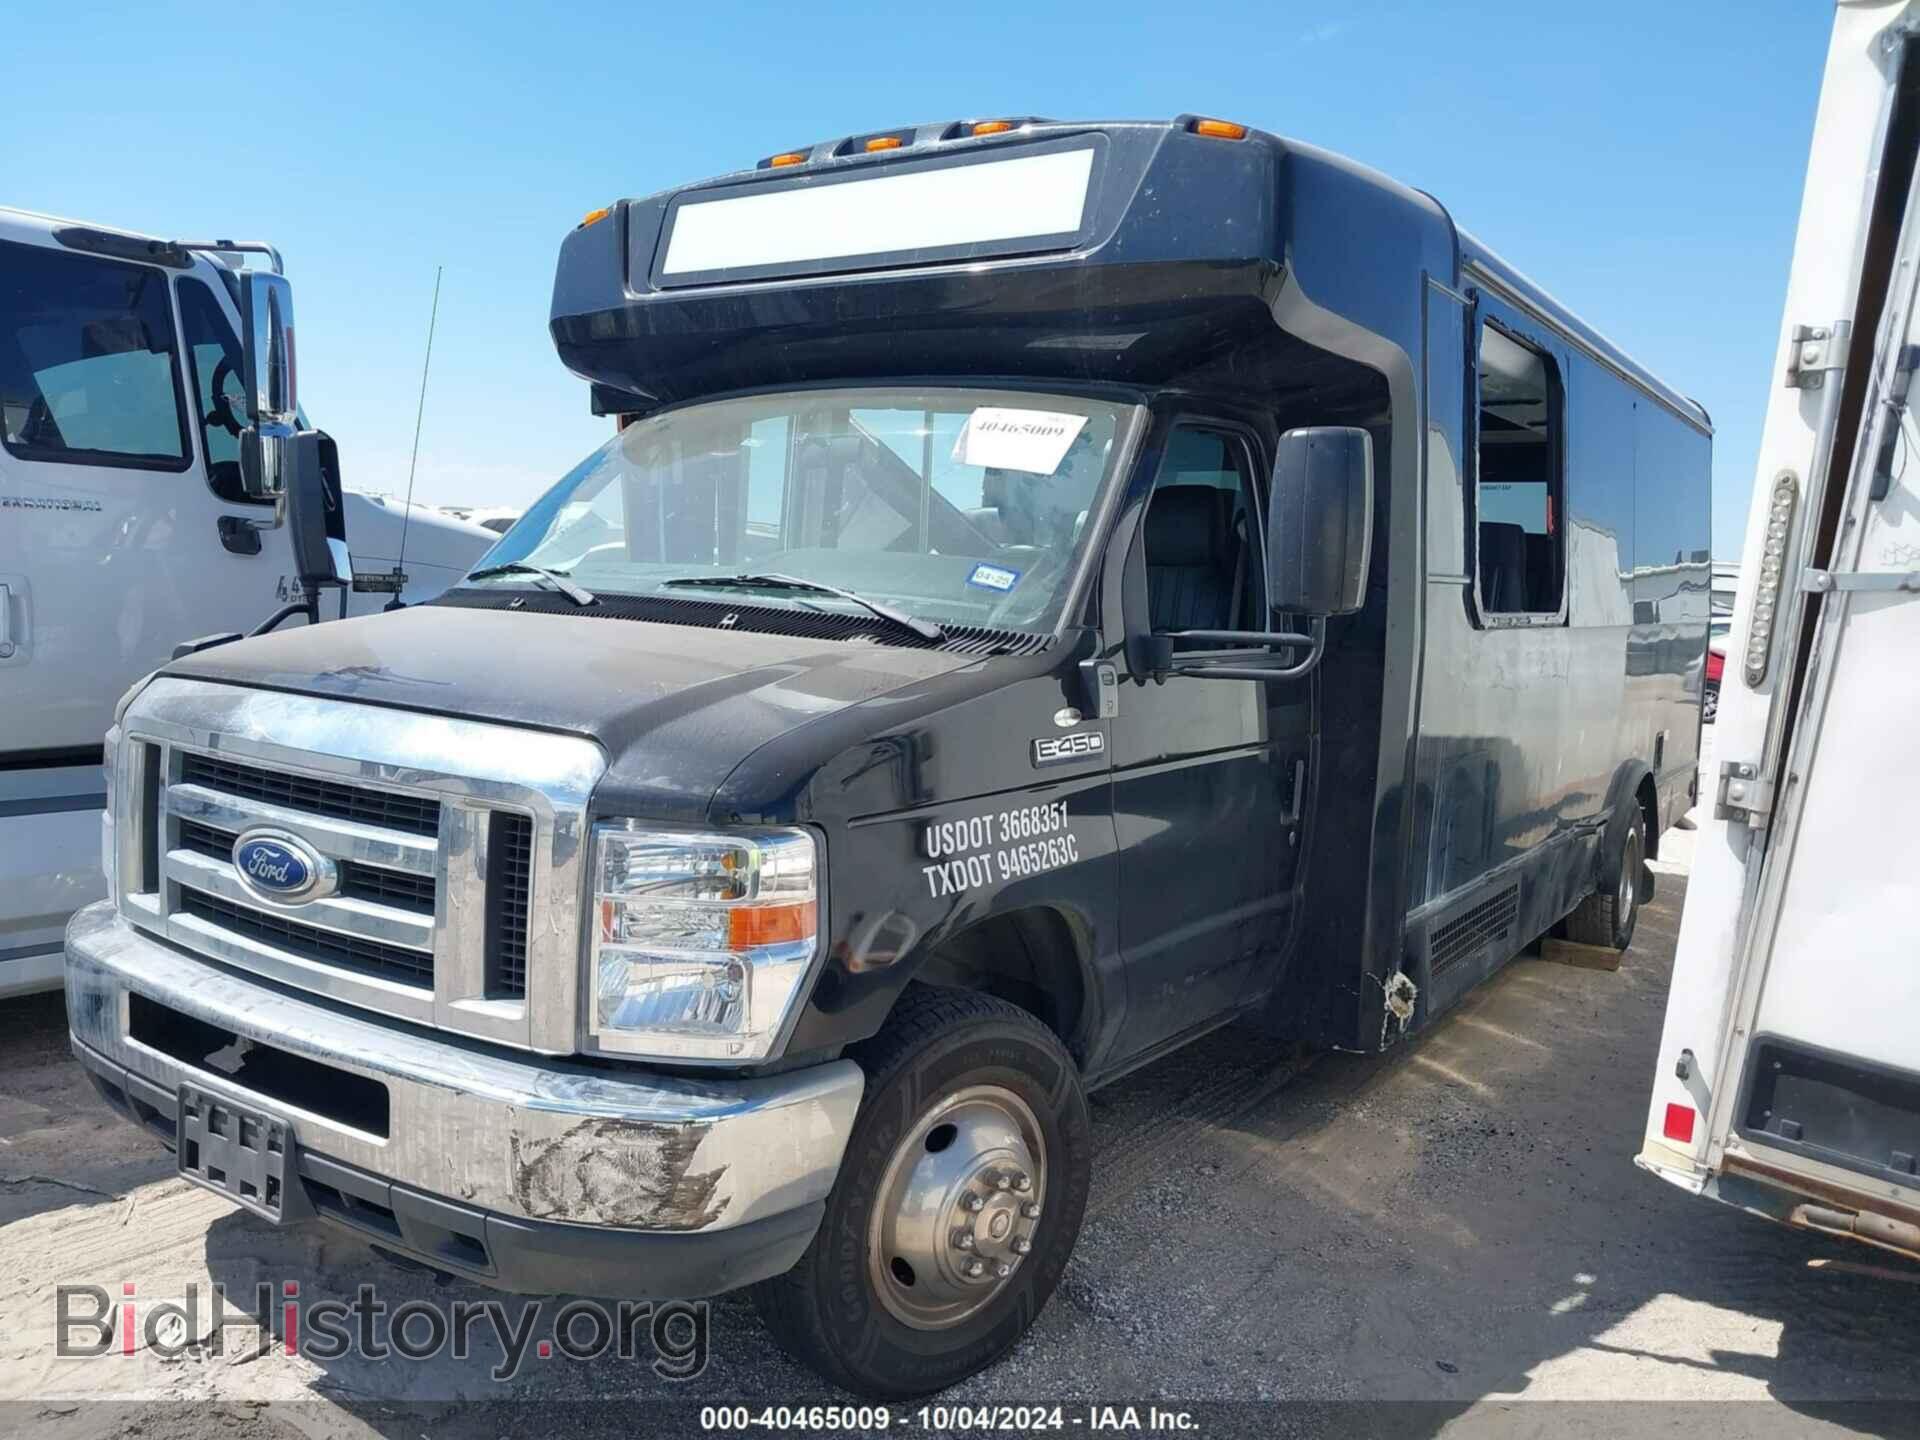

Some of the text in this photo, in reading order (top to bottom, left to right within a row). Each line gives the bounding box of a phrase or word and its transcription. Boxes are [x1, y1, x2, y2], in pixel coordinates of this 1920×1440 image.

[976, 421, 1066, 438] 40465009
[926, 800, 1069, 858] USDOT 3668351
[248, 847, 290, 882] Ford
[922, 834, 1079, 898] TXDOT 9465263C
